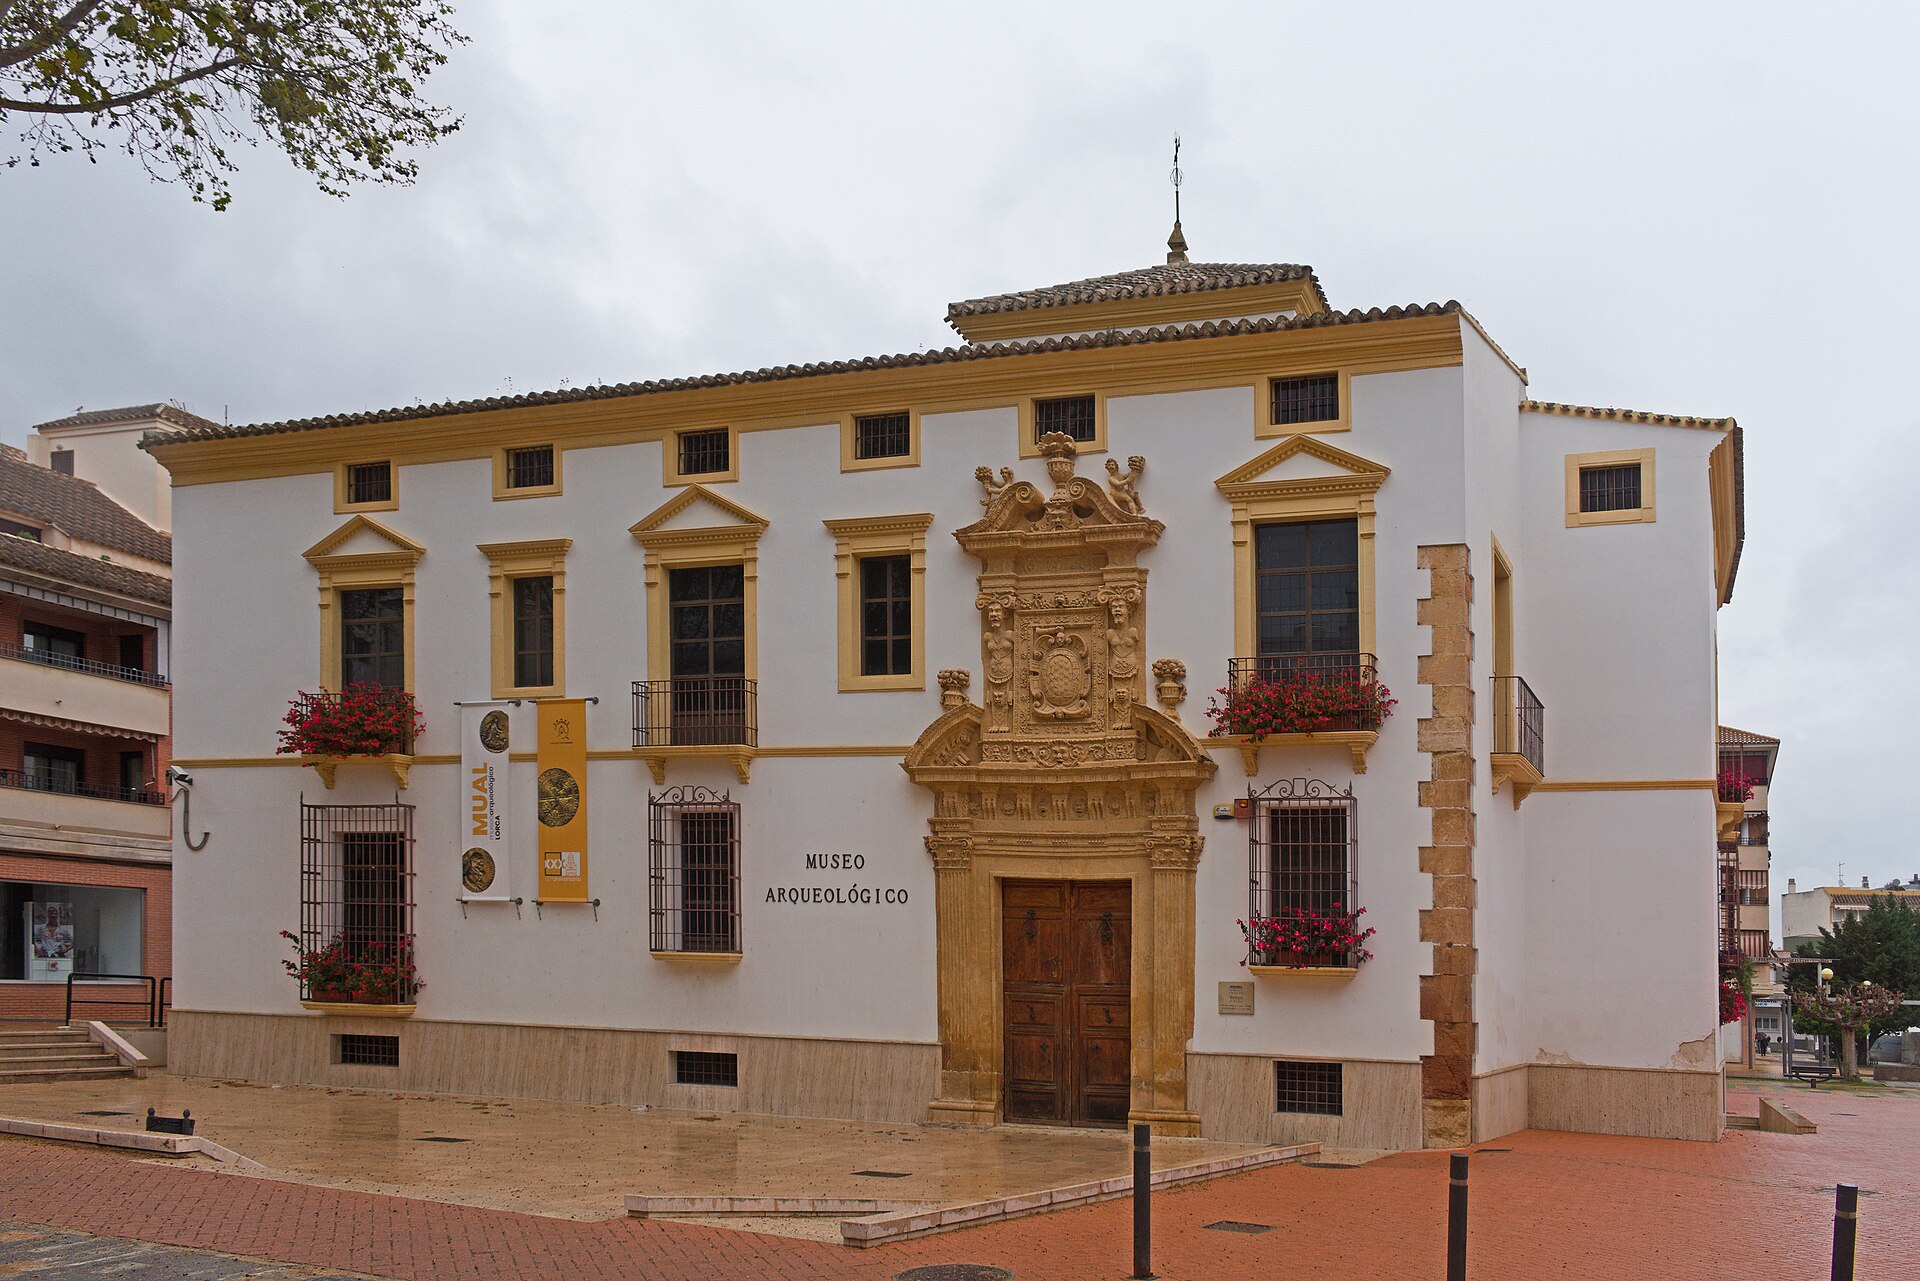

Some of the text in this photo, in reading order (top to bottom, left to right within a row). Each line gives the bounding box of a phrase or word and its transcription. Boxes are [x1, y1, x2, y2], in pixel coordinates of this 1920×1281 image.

[472, 762, 488, 836] MUAL
[805, 853, 866, 870] MUSEO
[765, 883, 909, 905] ARQUEOLÓGICO
